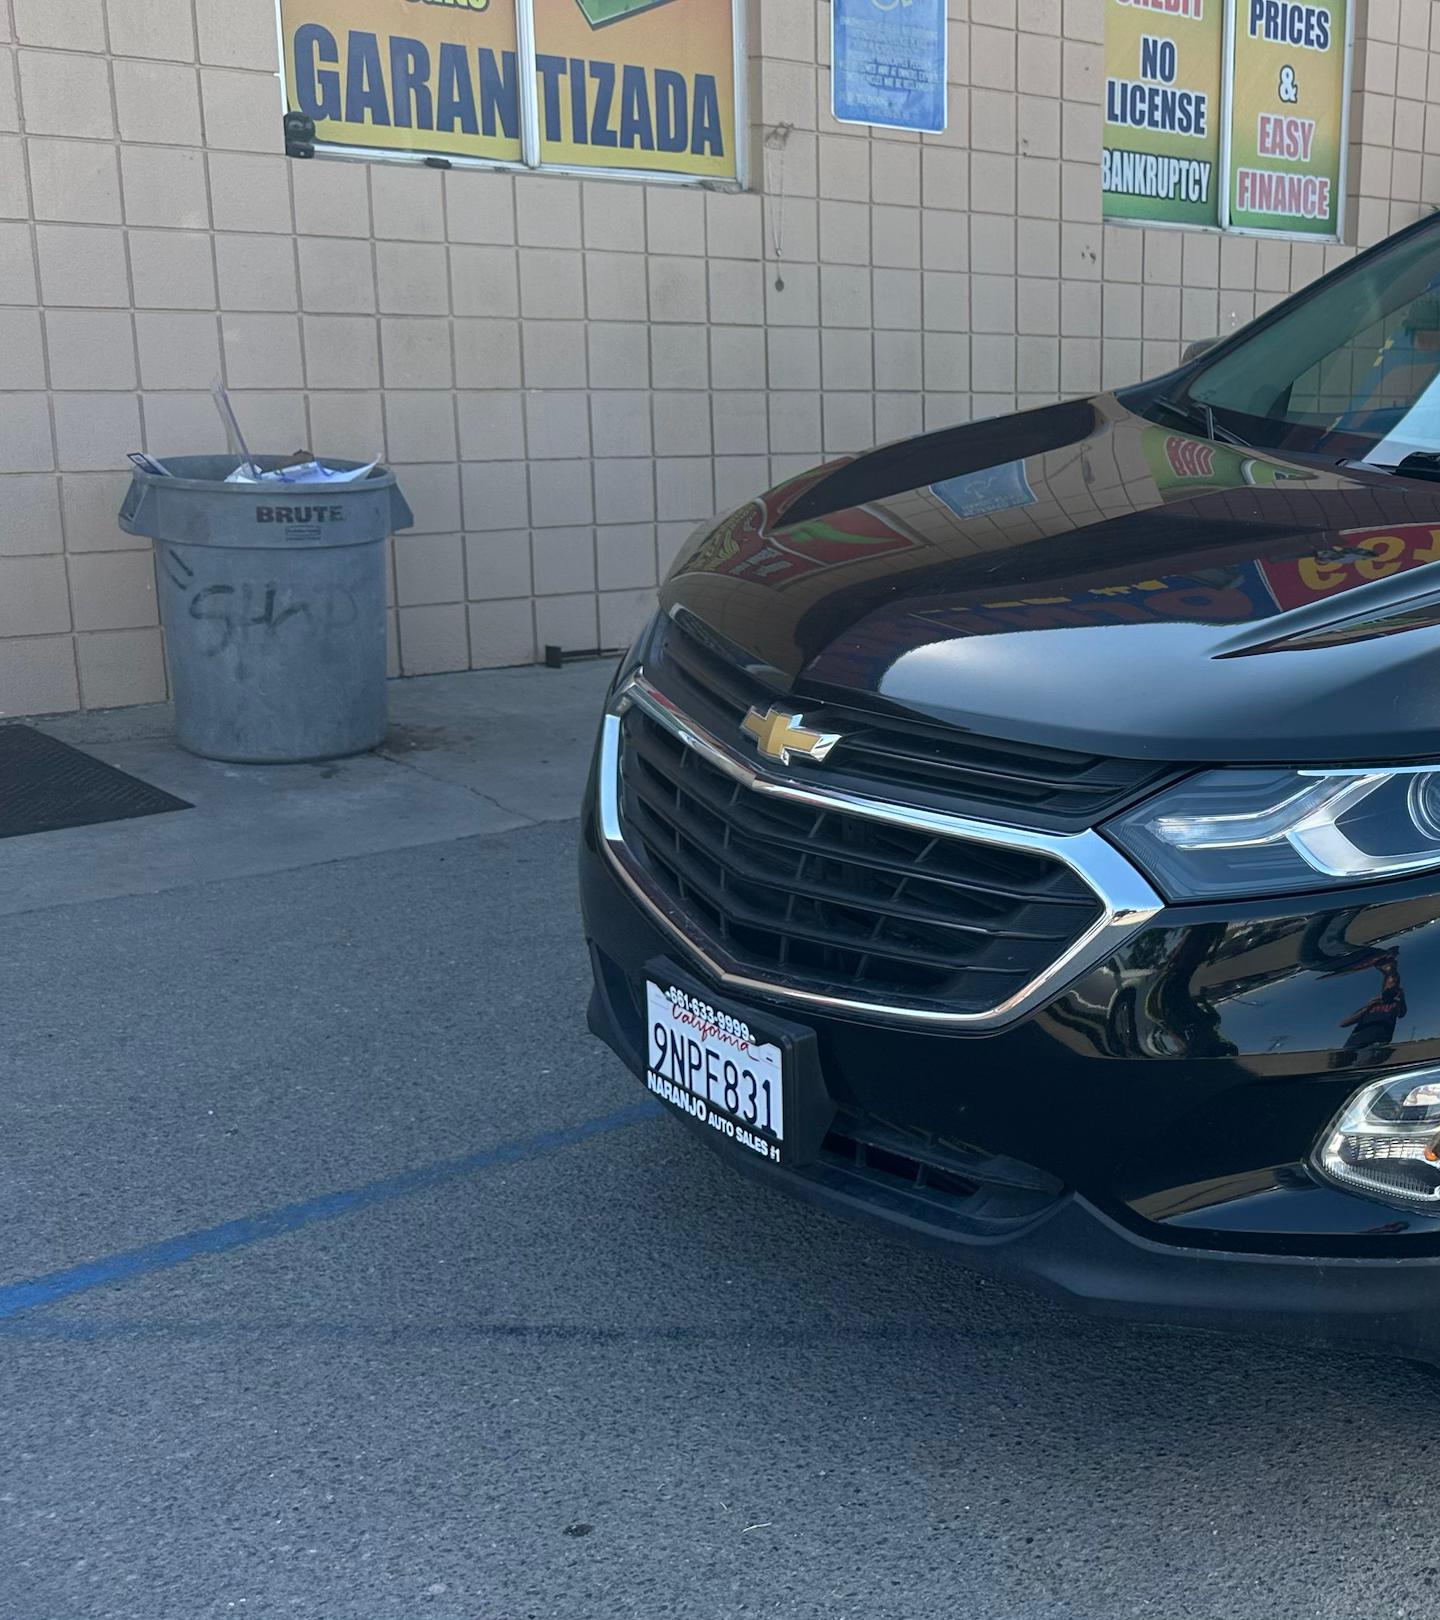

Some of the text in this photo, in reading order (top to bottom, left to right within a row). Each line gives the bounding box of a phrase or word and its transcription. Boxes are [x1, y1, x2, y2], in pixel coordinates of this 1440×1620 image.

[1249, 0, 1330, 51] PRICES
[1141, 37, 1176, 83] NO
[1278, 64, 1298, 103] &
[294, 23, 725, 157] GARANTIZADA
[1106, 81, 1207, 138] LICENSE
[1258, 112, 1314, 162] EASY
[1102, 148, 1211, 203] BANKRUPTCY
[1236, 167, 1330, 220] FINANCE
[256, 505, 346, 524] BRUTE
[653, 1022, 779, 1137] 9NPF831
[648, 1070, 707, 1122] NARANJO
[708, 1111, 735, 1137] AUTO
[735, 1126, 769, 1156] SALES
